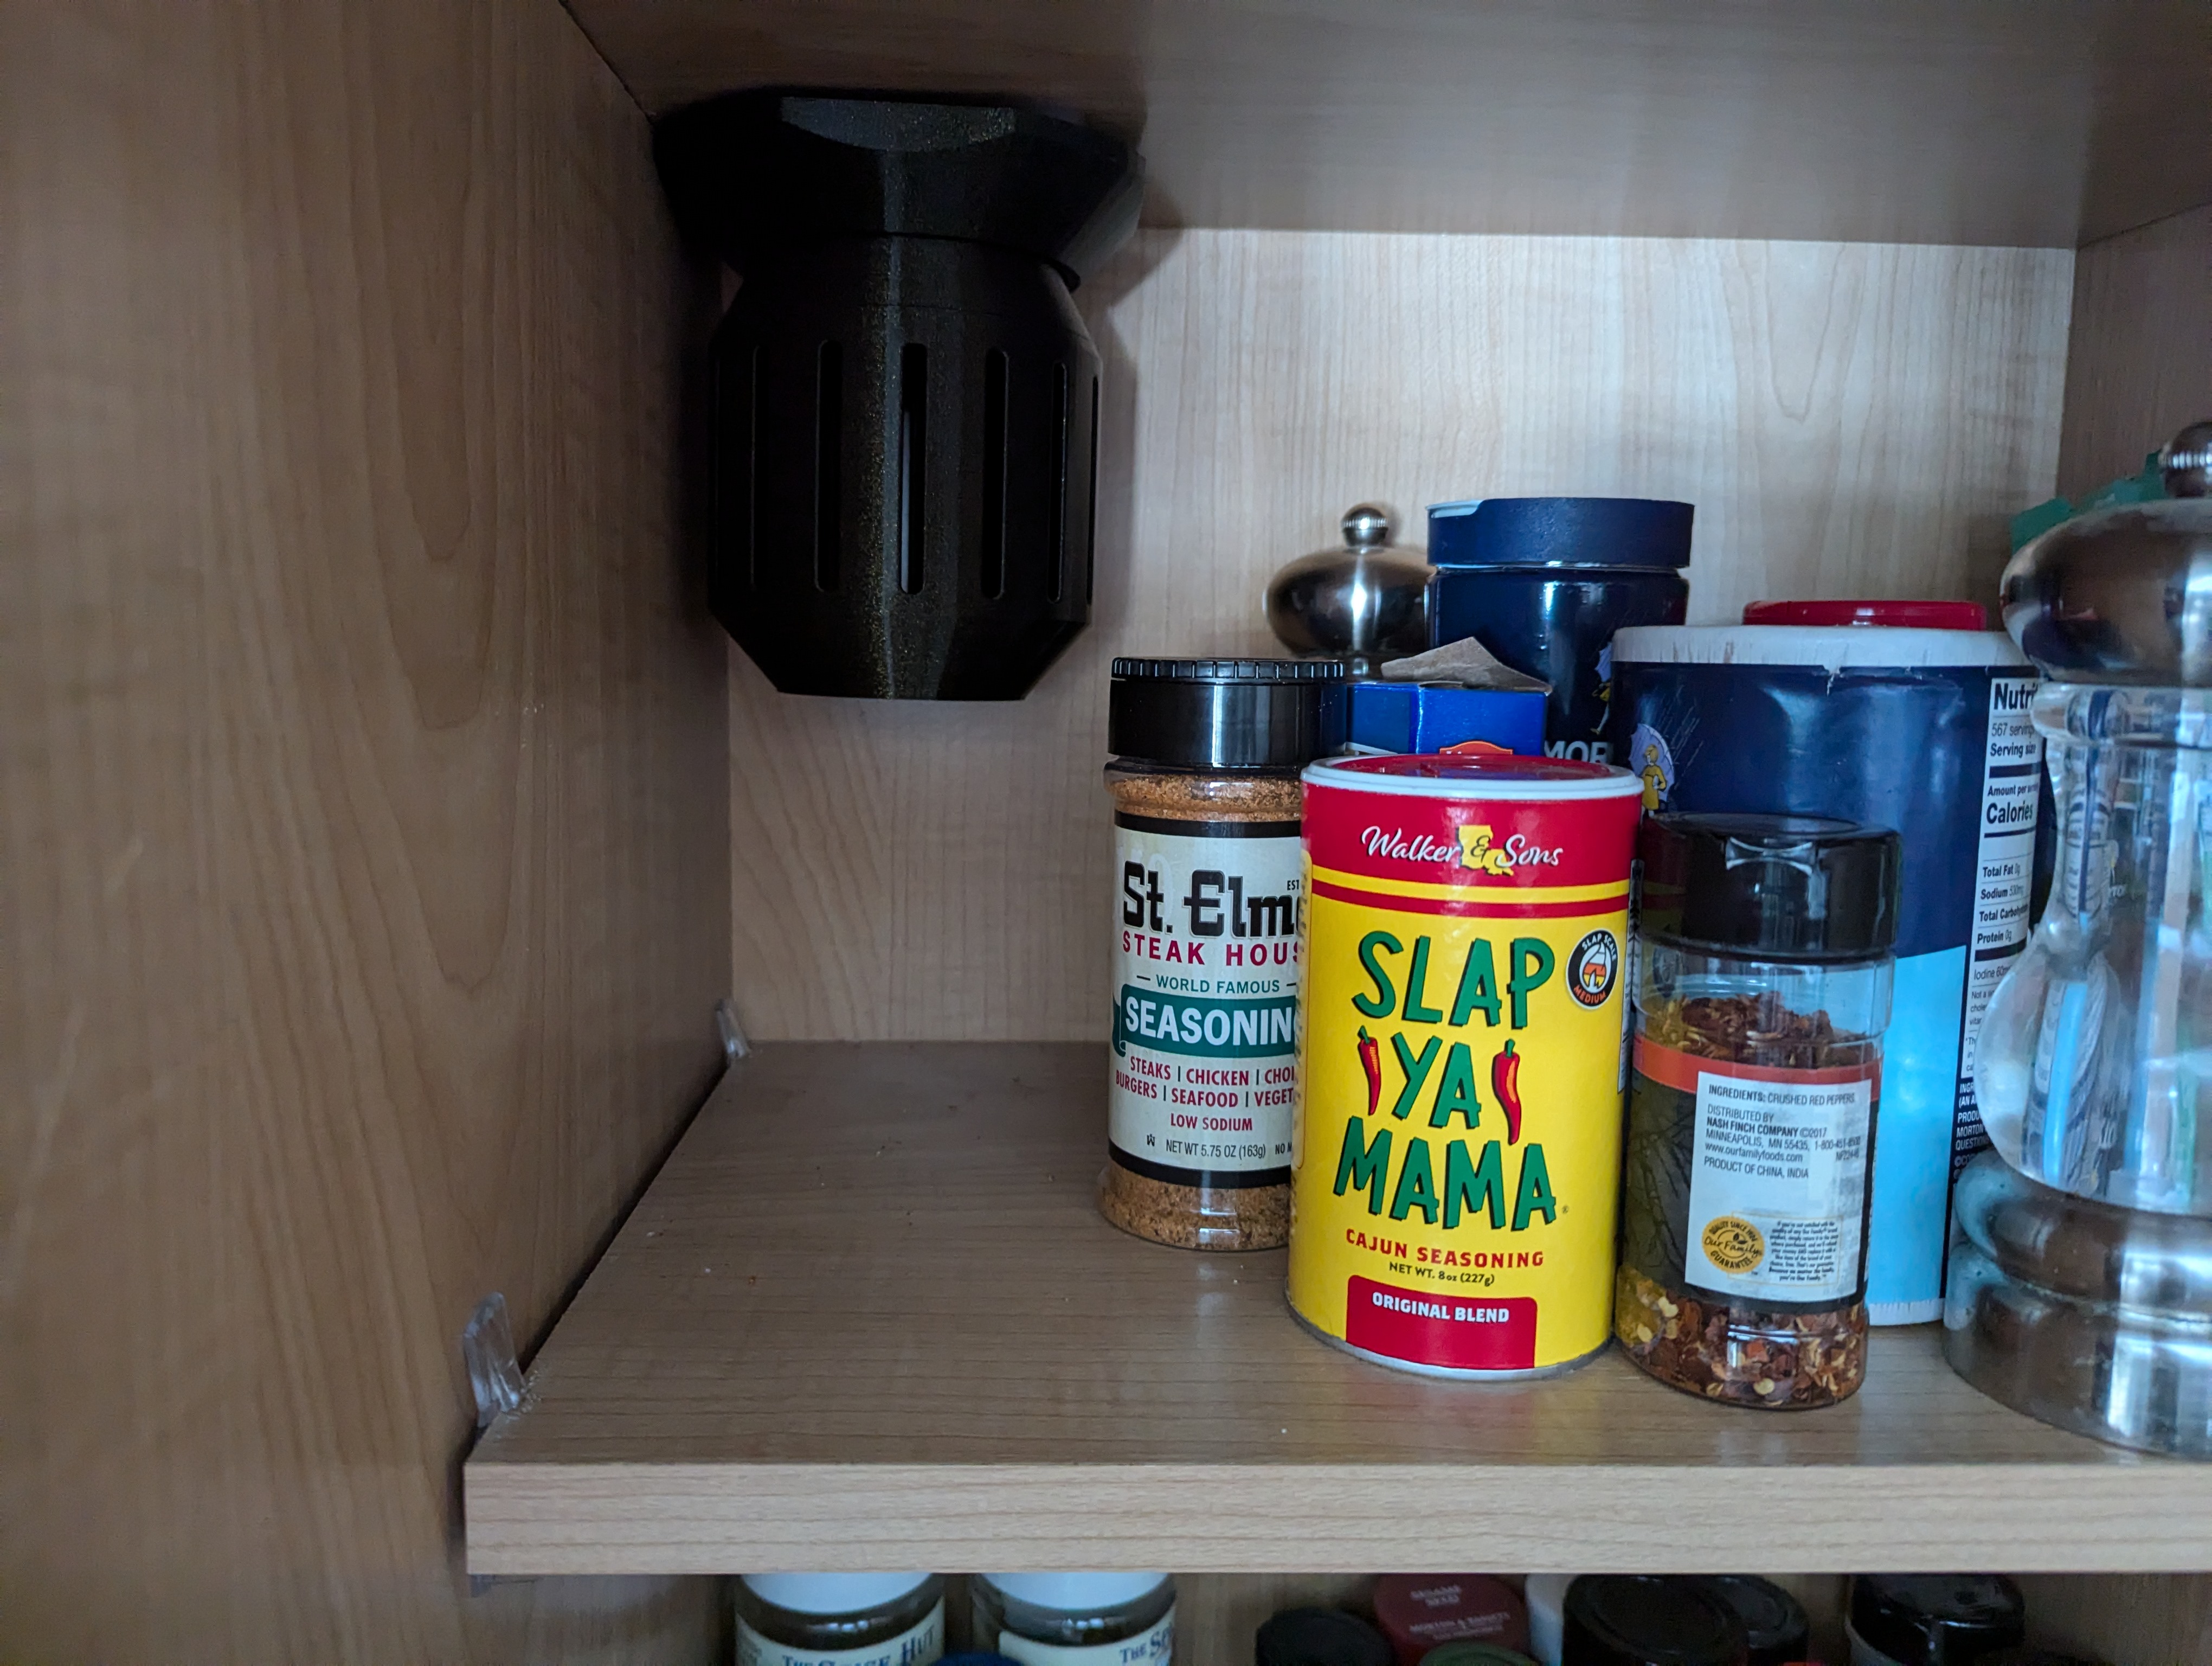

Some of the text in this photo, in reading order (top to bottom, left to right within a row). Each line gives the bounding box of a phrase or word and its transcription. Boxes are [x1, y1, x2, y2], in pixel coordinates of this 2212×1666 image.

[1994, 683, 2038, 710] Nutri
[1992, 722, 2008, 736] 567
[1990, 742, 2023, 759] Serving
[1988, 784, 2016, 797] Amount
[2017, 785, 2027, 797] per
[1986, 800, 2033, 824] Calories
[1360, 825, 1564, 868] Walker & Sons
[1982, 865, 2002, 878] Total
[2003, 864, 2014, 876] Fat
[1123, 860, 1300, 938] St. Elm
[1980, 887, 2008, 900] Sodium
[1979, 909, 1998, 922] Total
[1122, 930, 1205, 966] STEAK
[1581, 933, 1617, 962] SLAP SCALE
[1977, 930, 2004, 945] Protein
[1155, 974, 1280, 994] WORLD FAMOUS
[1351, 930, 1555, 1029] SLAP
[1974, 969, 1995, 981] Iodine
[1573, 984, 1607, 1004] MEDIUM
[1971, 990, 1982, 999] Not
[1125, 996, 1296, 1046] SEASONIN
[1130, 1055, 1171, 1080] STEAKS
[1186, 1068, 1249, 1086] CHICKEN
[1390, 1031, 1482, 1130] YA
[1115, 1068, 1294, 1108] BURGERS SEAFOOD VEGET
[1708, 1084, 1766, 1103] INGREDIENTS:
[1767, 1092, 1808, 1106] CRUSHED
[1809, 1094, 1825, 1106] RED
[1170, 1112, 1253, 1131] LOW SODIUM
[1707, 1104, 1774, 1123] DISTRIBUTED BY
[1706, 1127, 1764, 1149] MINNEAPOLIS,
[1767, 1137, 1783, 1149] MN
[1707, 1116, 1729, 1130] NASH
[1730, 1120, 1756, 1134] FINCH
[1757, 1124, 1799, 1138] COMPANY
[1956, 1123, 1984, 1138] MORTON
[1166, 1138, 1266, 1161] NET WT 5.75 OZ (163g)
[1275, 1143, 1285, 1155] NO
[1705, 1142, 1803, 1163] www.ourfamilyfoods.com
[1333, 1115, 1557, 1232] MAMA
[1703, 1156, 1809, 1179] PRODUCT OF CHINA, INDIA
[1345, 1228, 1544, 1268] CAJUN SEASONING
[1703, 1235, 1723, 1247] Our
[1724, 1240, 1759, 1259] Family
[1388, 1261, 1495, 1287] NET WT. 8oz (227g)
[1372, 1291, 1510, 1323] ORIGINAL BLEND
